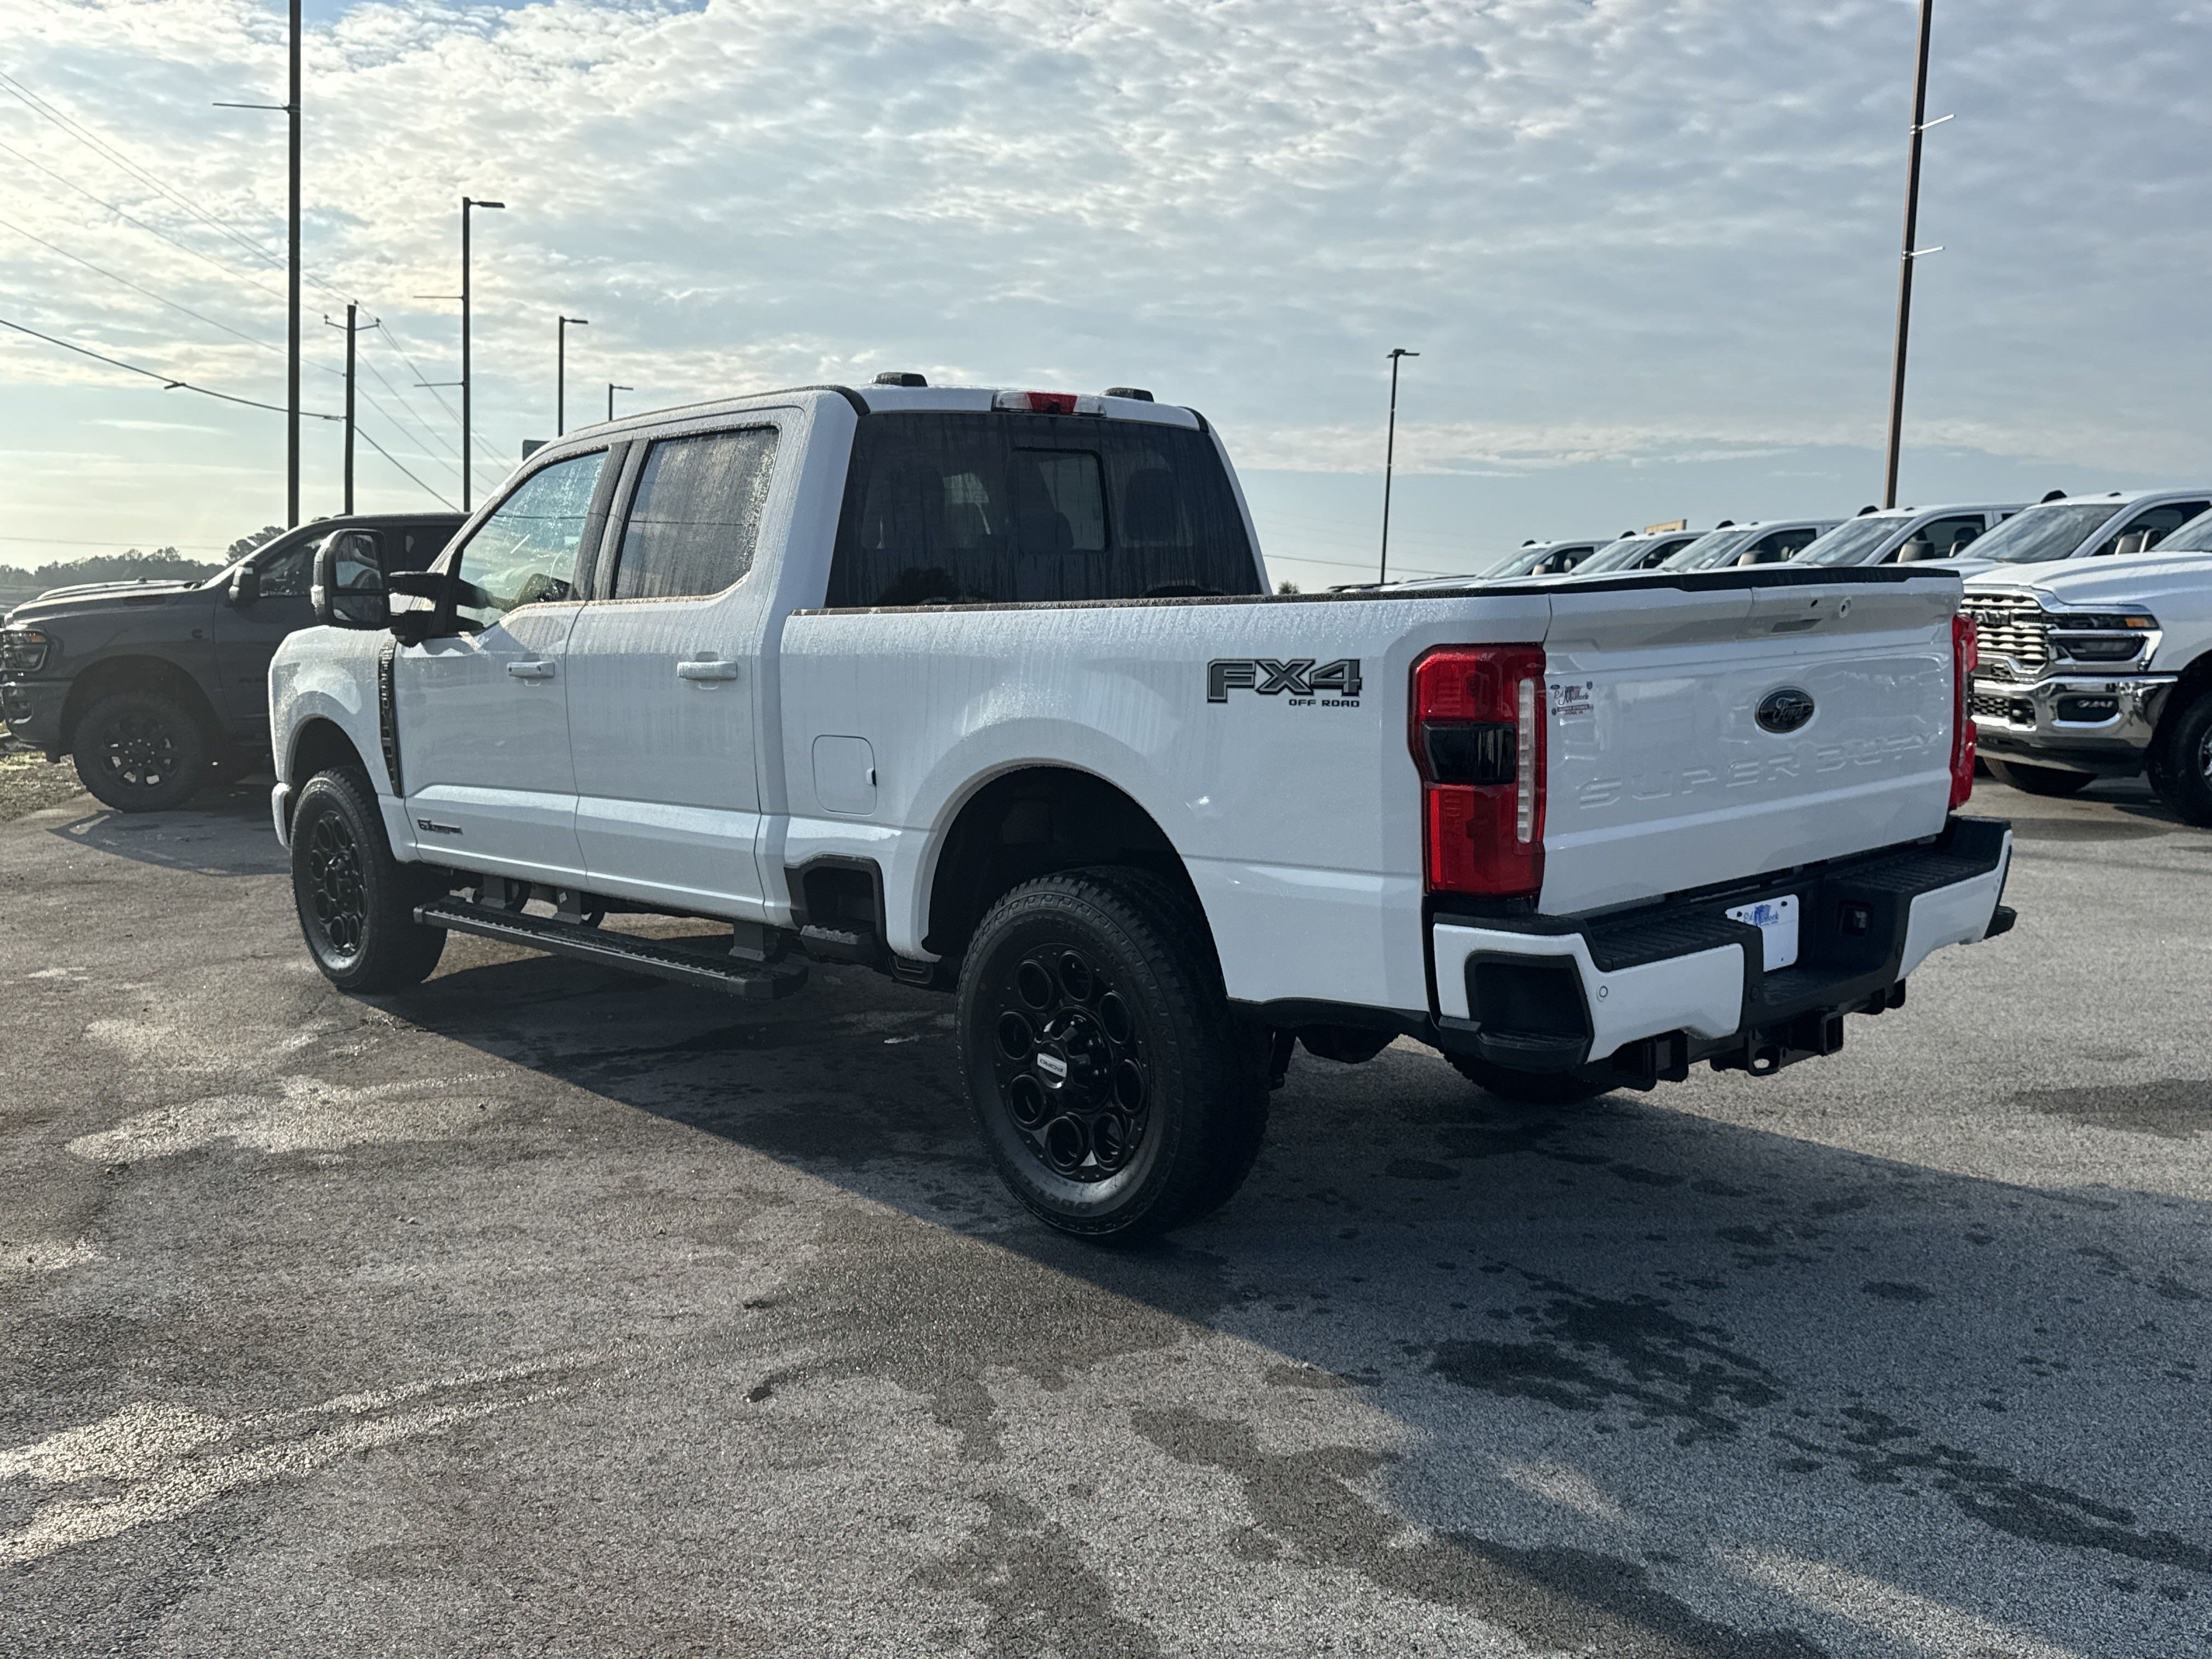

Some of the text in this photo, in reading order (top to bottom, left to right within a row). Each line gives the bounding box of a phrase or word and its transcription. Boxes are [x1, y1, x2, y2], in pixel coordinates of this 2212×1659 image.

[1207, 658, 1362, 703] FX4
[1773, 697, 1804, 724] Ford
[1578, 732, 1939, 810] SUPER DUTY
[1040, 1058, 1063, 1073] FORD
